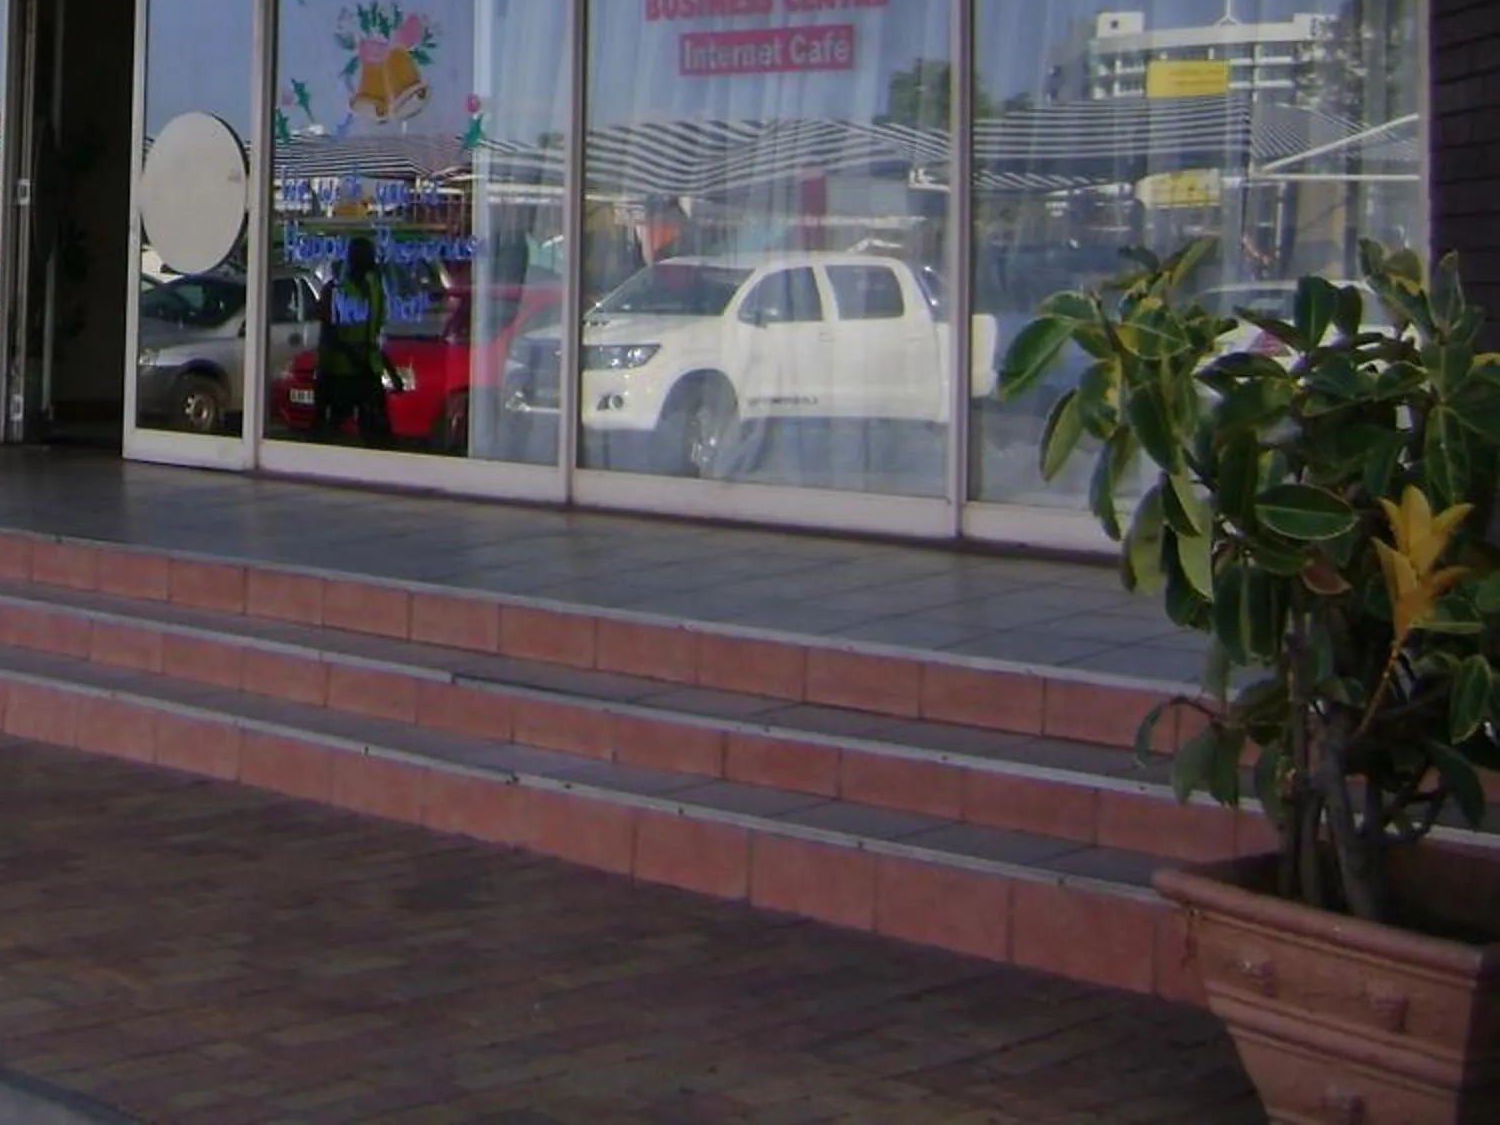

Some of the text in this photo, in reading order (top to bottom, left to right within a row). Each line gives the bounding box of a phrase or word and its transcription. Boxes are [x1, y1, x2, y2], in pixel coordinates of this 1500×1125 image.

[683, 38, 784, 71] Internet
[283, 220, 350, 278] Happy
[333, 287, 370, 324] New
